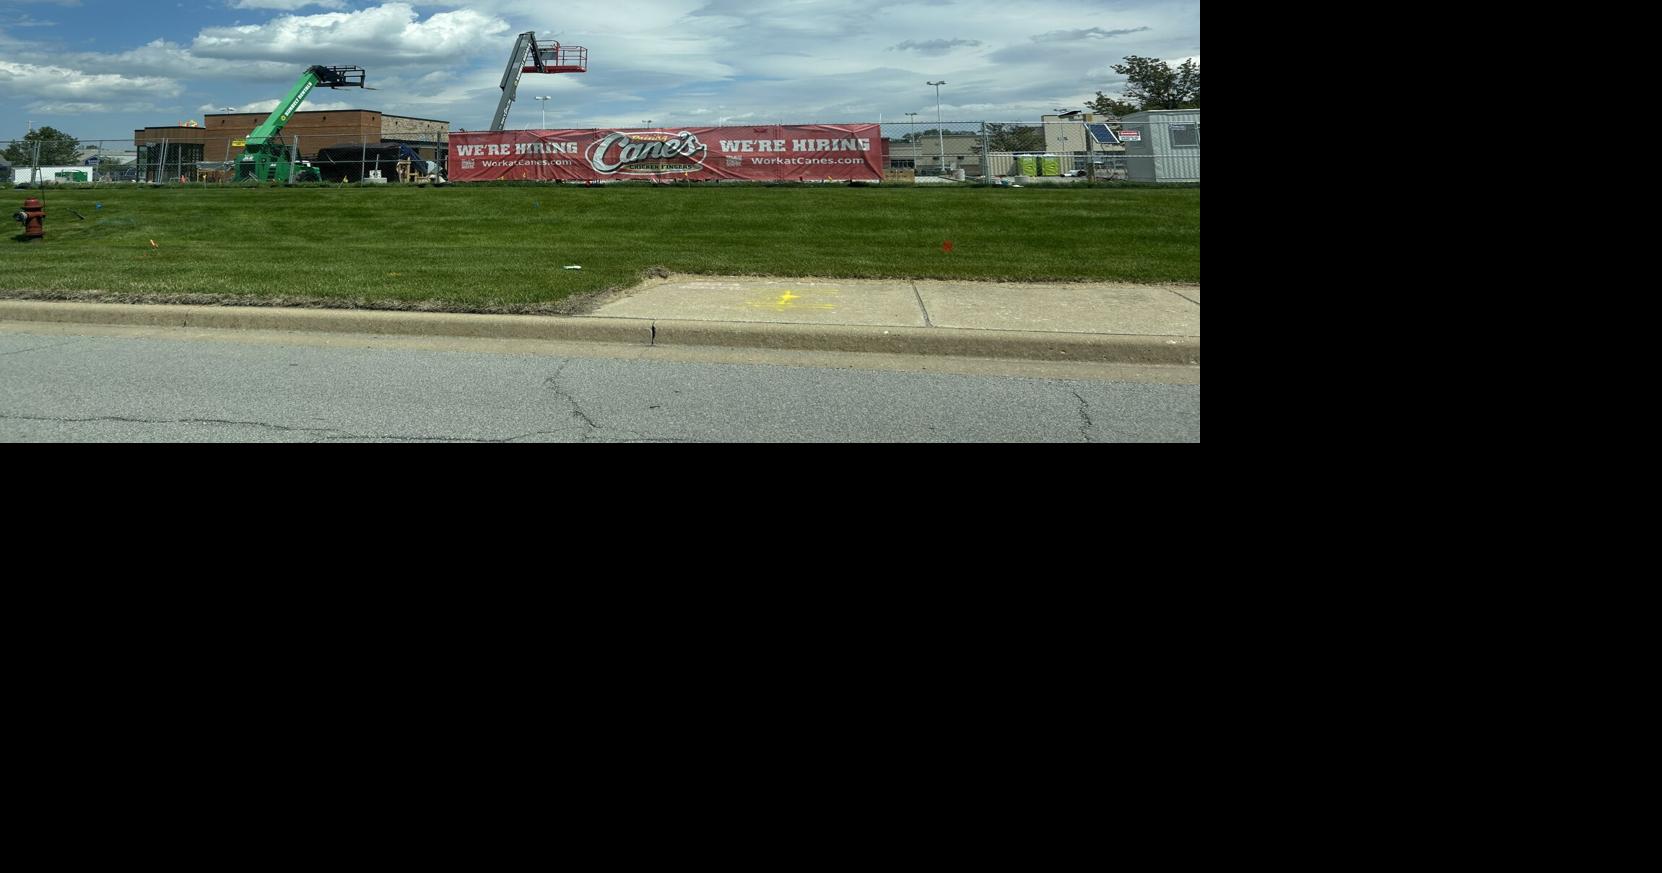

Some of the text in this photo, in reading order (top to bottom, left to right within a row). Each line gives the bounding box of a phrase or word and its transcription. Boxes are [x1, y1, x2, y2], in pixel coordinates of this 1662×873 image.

[456, 141, 578, 156] WE'RE HIRING
[592, 131, 700, 172] Cane's
[719, 138, 871, 153] WE'RE HIRING
[751, 156, 865, 165] WorkatCanes.com
